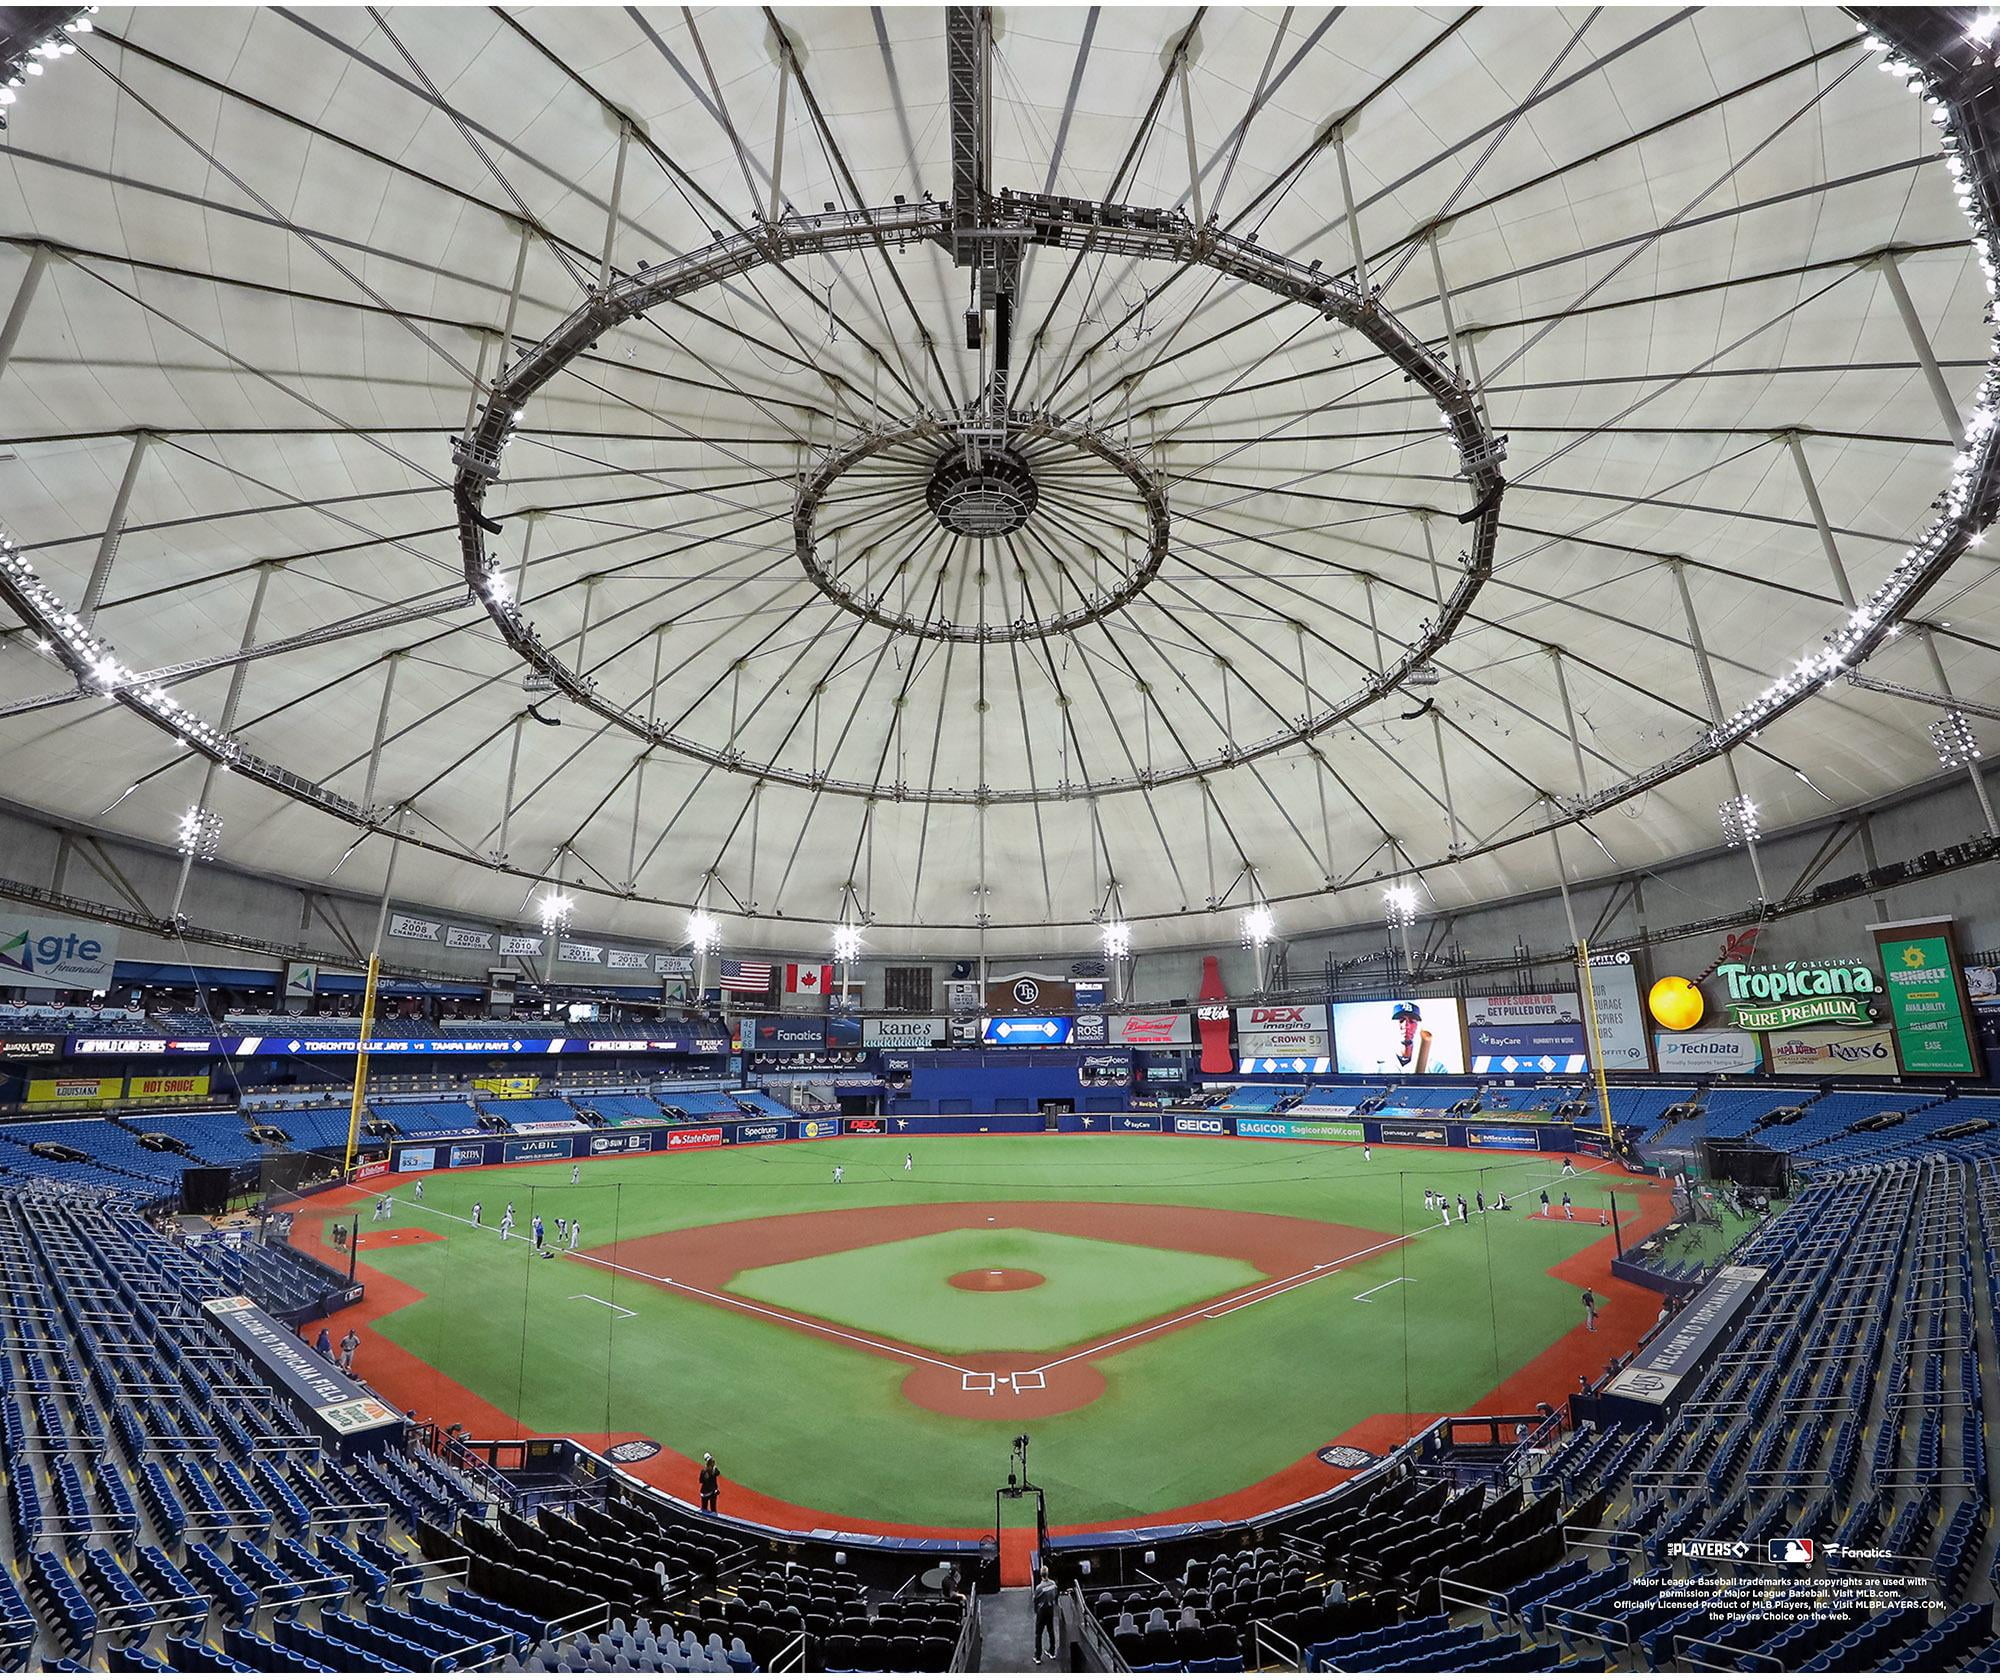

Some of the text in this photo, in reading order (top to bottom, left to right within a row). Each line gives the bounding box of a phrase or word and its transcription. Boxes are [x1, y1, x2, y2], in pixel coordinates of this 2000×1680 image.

[402, 922, 428, 934] 2008
[392, 929, 433, 939] CHAMPIONS
[457, 934, 481, 943] 2008
[36, 933, 102, 965] gte
[449, 940, 487, 949] CHAMPIONS
[509, 942, 532, 950] 2010
[569, 948, 591, 957] 2011
[617, 955, 639, 964] 2013
[663, 960, 682, 968] 2019
[1801, 958, 1863, 969] ORIGINAL
[45, 961, 107, 976] financial
[1889, 968, 1946, 982] SUNBELT
[1717, 963, 1874, 1002] Tropicana
[1018, 984, 1034, 1000] TB
[1488, 995, 1553, 1006] DRIVE SOBER OR
[1594, 999, 1622, 1010] OURAGE
[1488, 1005, 1557, 1017] GET PULLED OVER
[1905, 1002, 1946, 1012] AVAILABILITY
[1250, 1007, 1306, 1023] DEX
[1738, 1001, 1857, 1027] PURE PREMIUM
[1077, 1026, 1104, 1035] ROSE
[1263, 1022, 1311, 1030] imaging
[1910, 1021, 1948, 1031] RELIABILITY
[777, 1030, 822, 1041] Fanatics
[1271, 1035, 1306, 1044] CROWN
[304, 1042, 356, 1051] TORONTO
[384, 1042, 409, 1051] JAYS
[431, 1042, 464, 1051] TAMPA
[464, 1042, 485, 1051] BAY
[484, 1042, 510, 1051] RAYS
[1490, 1037, 1521, 1046] BayCare
[1924, 1041, 1942, 1050] EASE
[1680, 1043, 1739, 1054] Tech Data
[1827, 1042, 1888, 1062] RAYS 6
[57, 1086, 98, 1097] LOUISIANA
[143, 1080, 195, 1093] HOT SAUCE
[850, 1120, 877, 1129] DEX
[1176, 1121, 1221, 1132] GEICO
[1240, 1123, 1361, 1137] SAGICOR SagicorNOW.com
[744, 1126, 777, 1136] Spectrum
[522, 1141, 558, 1151] JABIL
[1647, 1334, 1697, 1371] WELCOME
[1680, 1324, 1704, 1335] TO
[230, 1309, 349, 1403] WELCOME TO TROPICANA FIELD
[1614, 1373, 1665, 1396] RAYS
